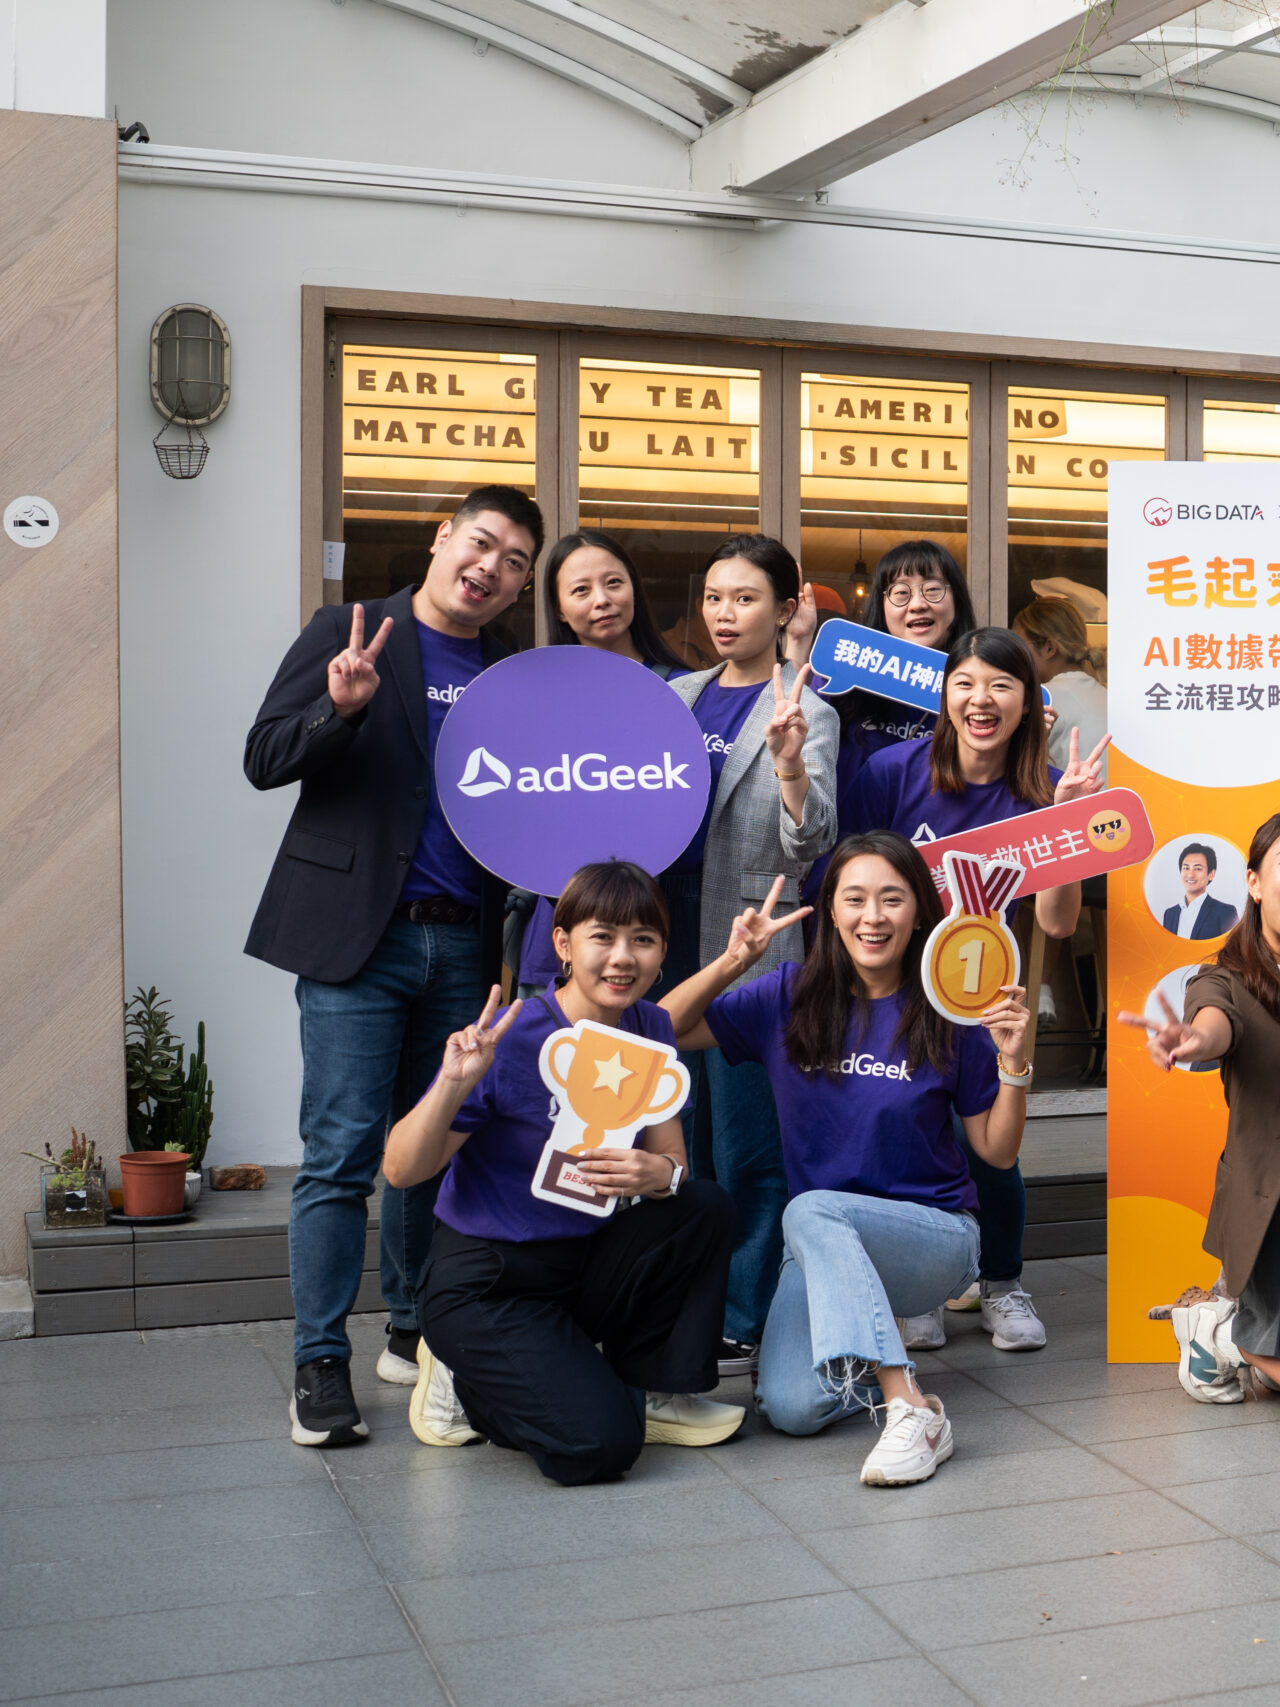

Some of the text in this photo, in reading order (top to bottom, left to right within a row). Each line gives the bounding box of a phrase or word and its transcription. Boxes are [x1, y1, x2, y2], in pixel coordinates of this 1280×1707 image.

[357, 370, 465, 396] EARL
[646, 386, 723, 410] TEA
[354, 419, 526, 449] MATCHA
[647, 434, 748, 459] LAIT
[1177, 504, 1211, 520] BIG
[1216, 505, 1264, 520] DATA
[516, 752, 691, 793] adGeek
[829, 1052, 915, 1082] dGeek
[563, 1171, 593, 1188] BES
